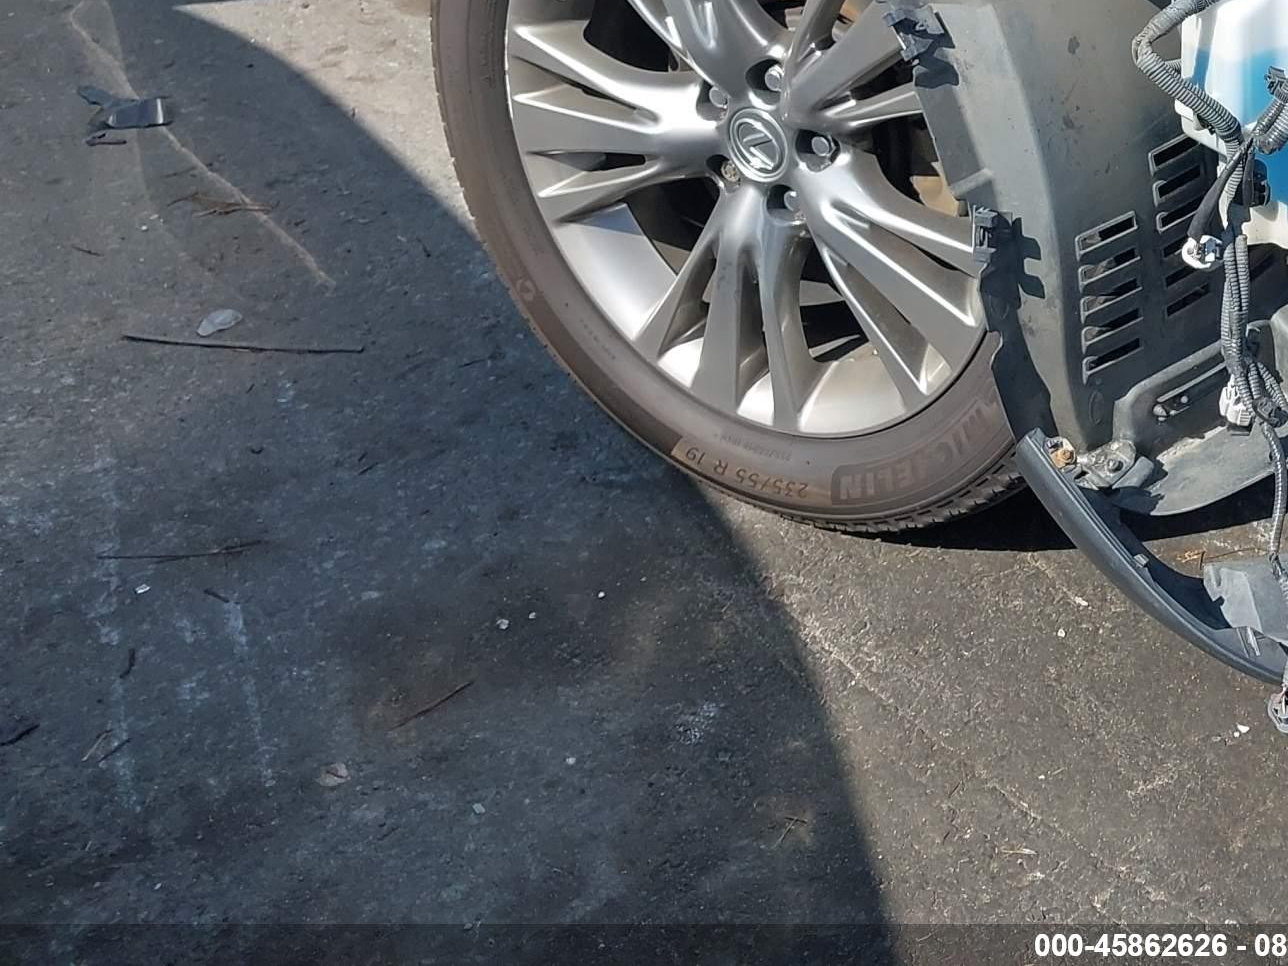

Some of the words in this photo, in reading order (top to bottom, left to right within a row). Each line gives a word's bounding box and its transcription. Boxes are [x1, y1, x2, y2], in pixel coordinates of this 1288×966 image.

[686, 446, 706, 466] 19
[713, 459, 729, 476] R
[735, 468, 809, 498] 235/55
